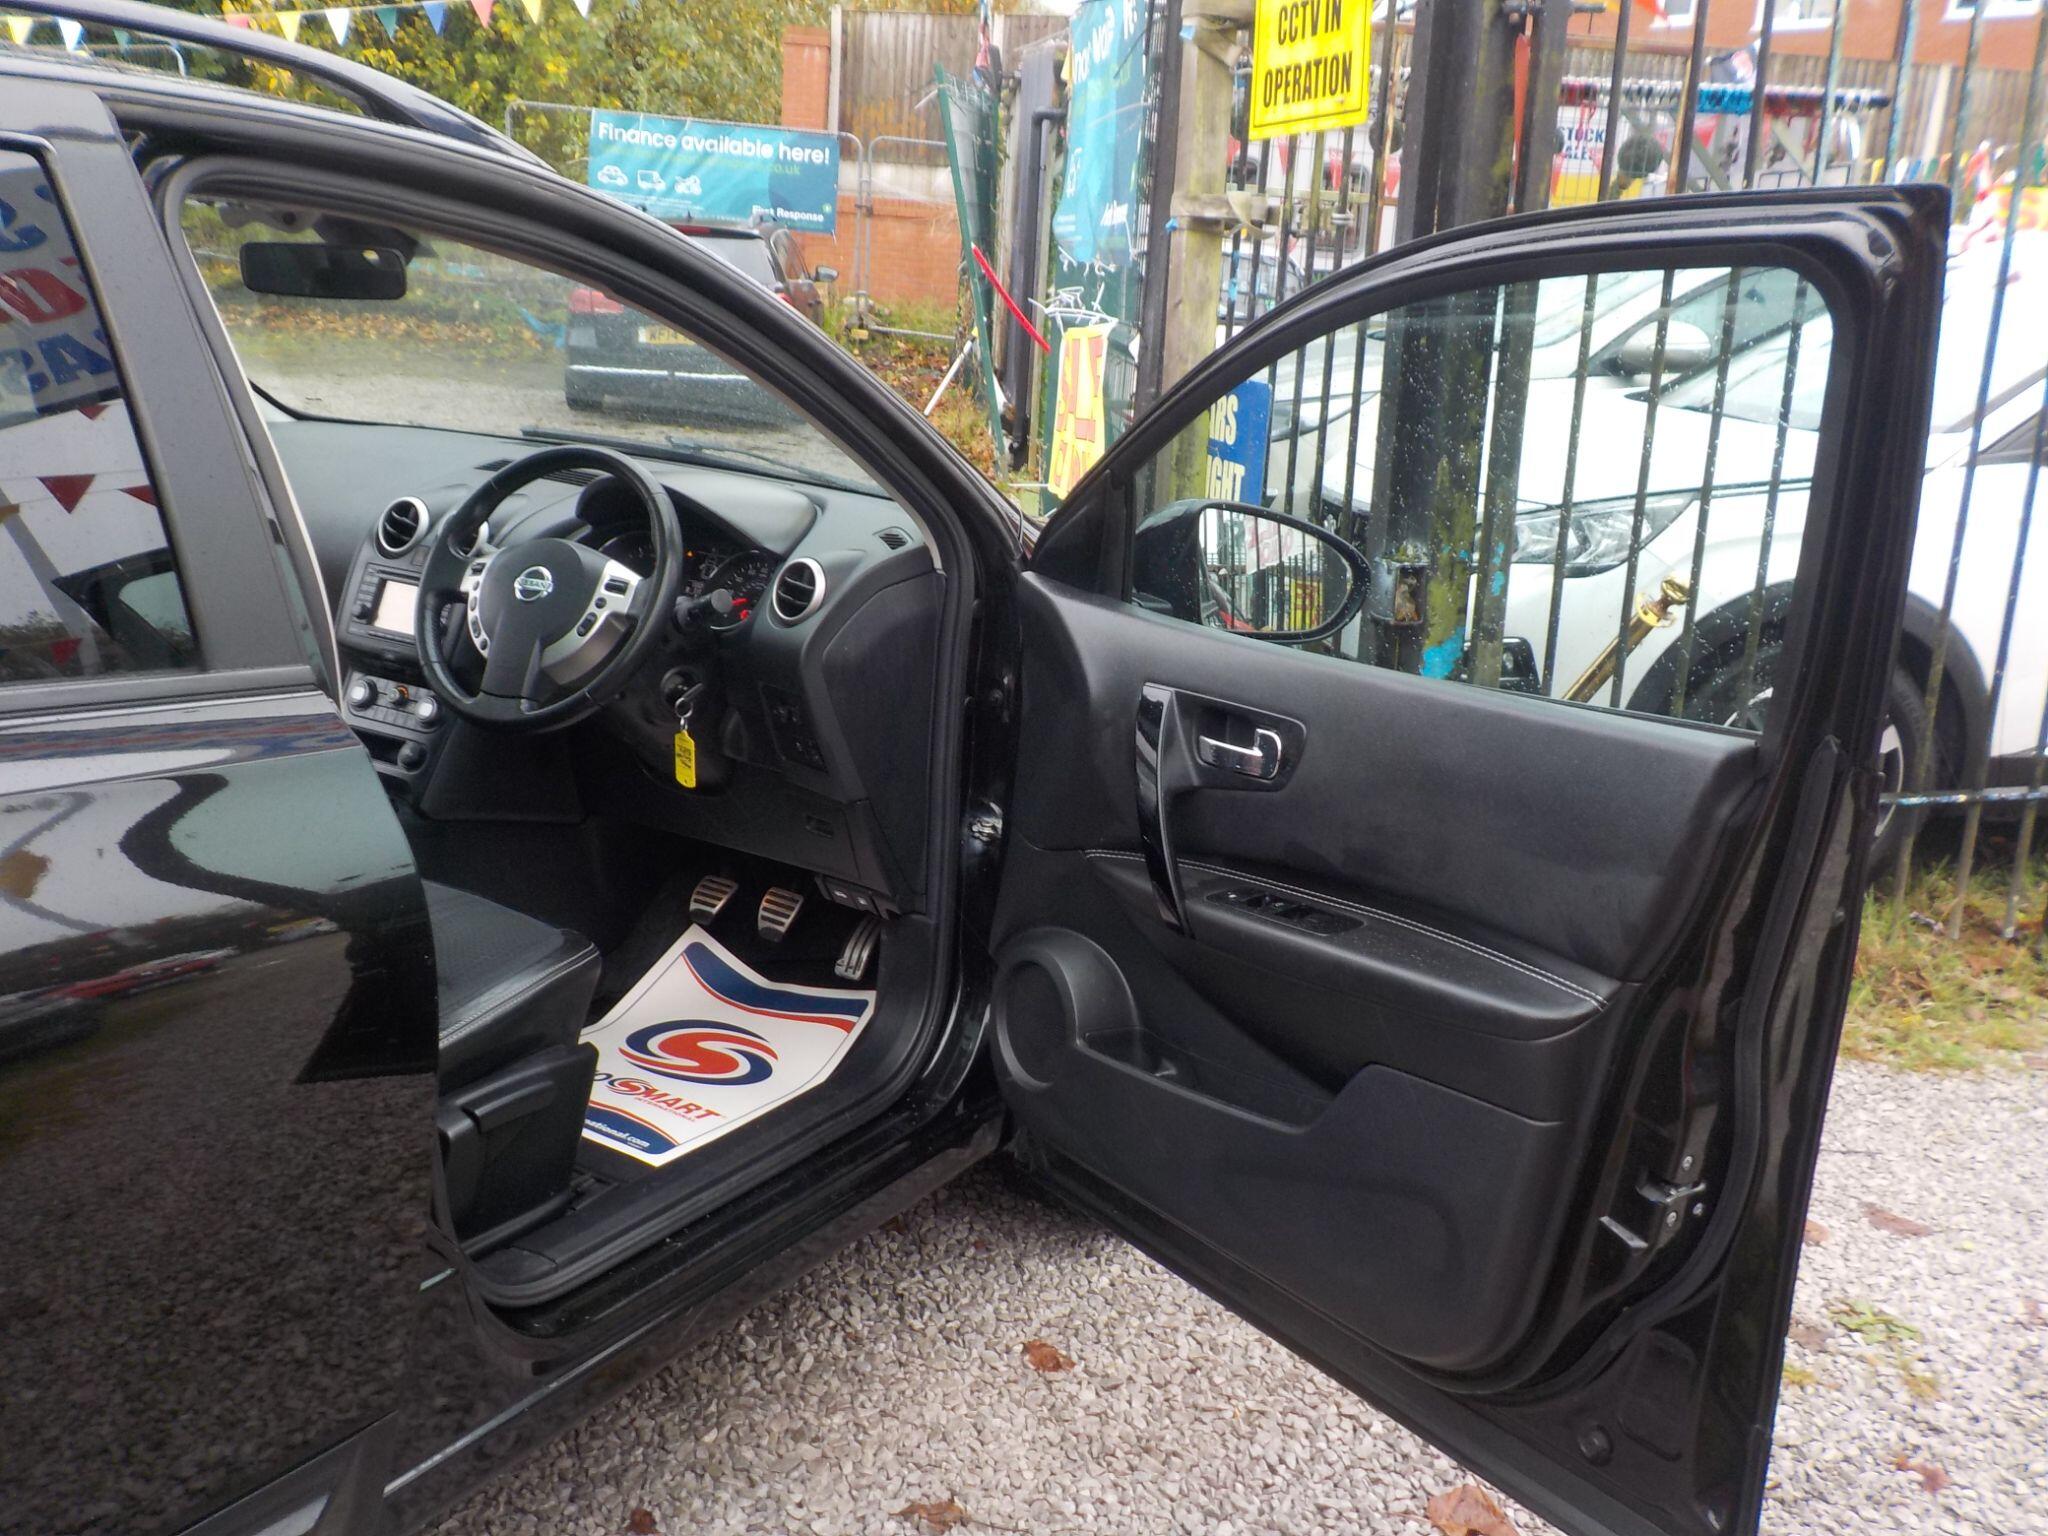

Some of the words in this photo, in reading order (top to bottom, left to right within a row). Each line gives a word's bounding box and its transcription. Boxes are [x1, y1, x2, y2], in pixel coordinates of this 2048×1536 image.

[1278, 0, 1320, 45] CCTV
[1325, 0, 1342, 33] IN
[1263, 51, 1353, 108] OPERATION
[598, 121, 676, 147] Finance
[681, 130, 774, 157] available
[778, 142, 830, 165] here!
[776, 207, 825, 223] Response
